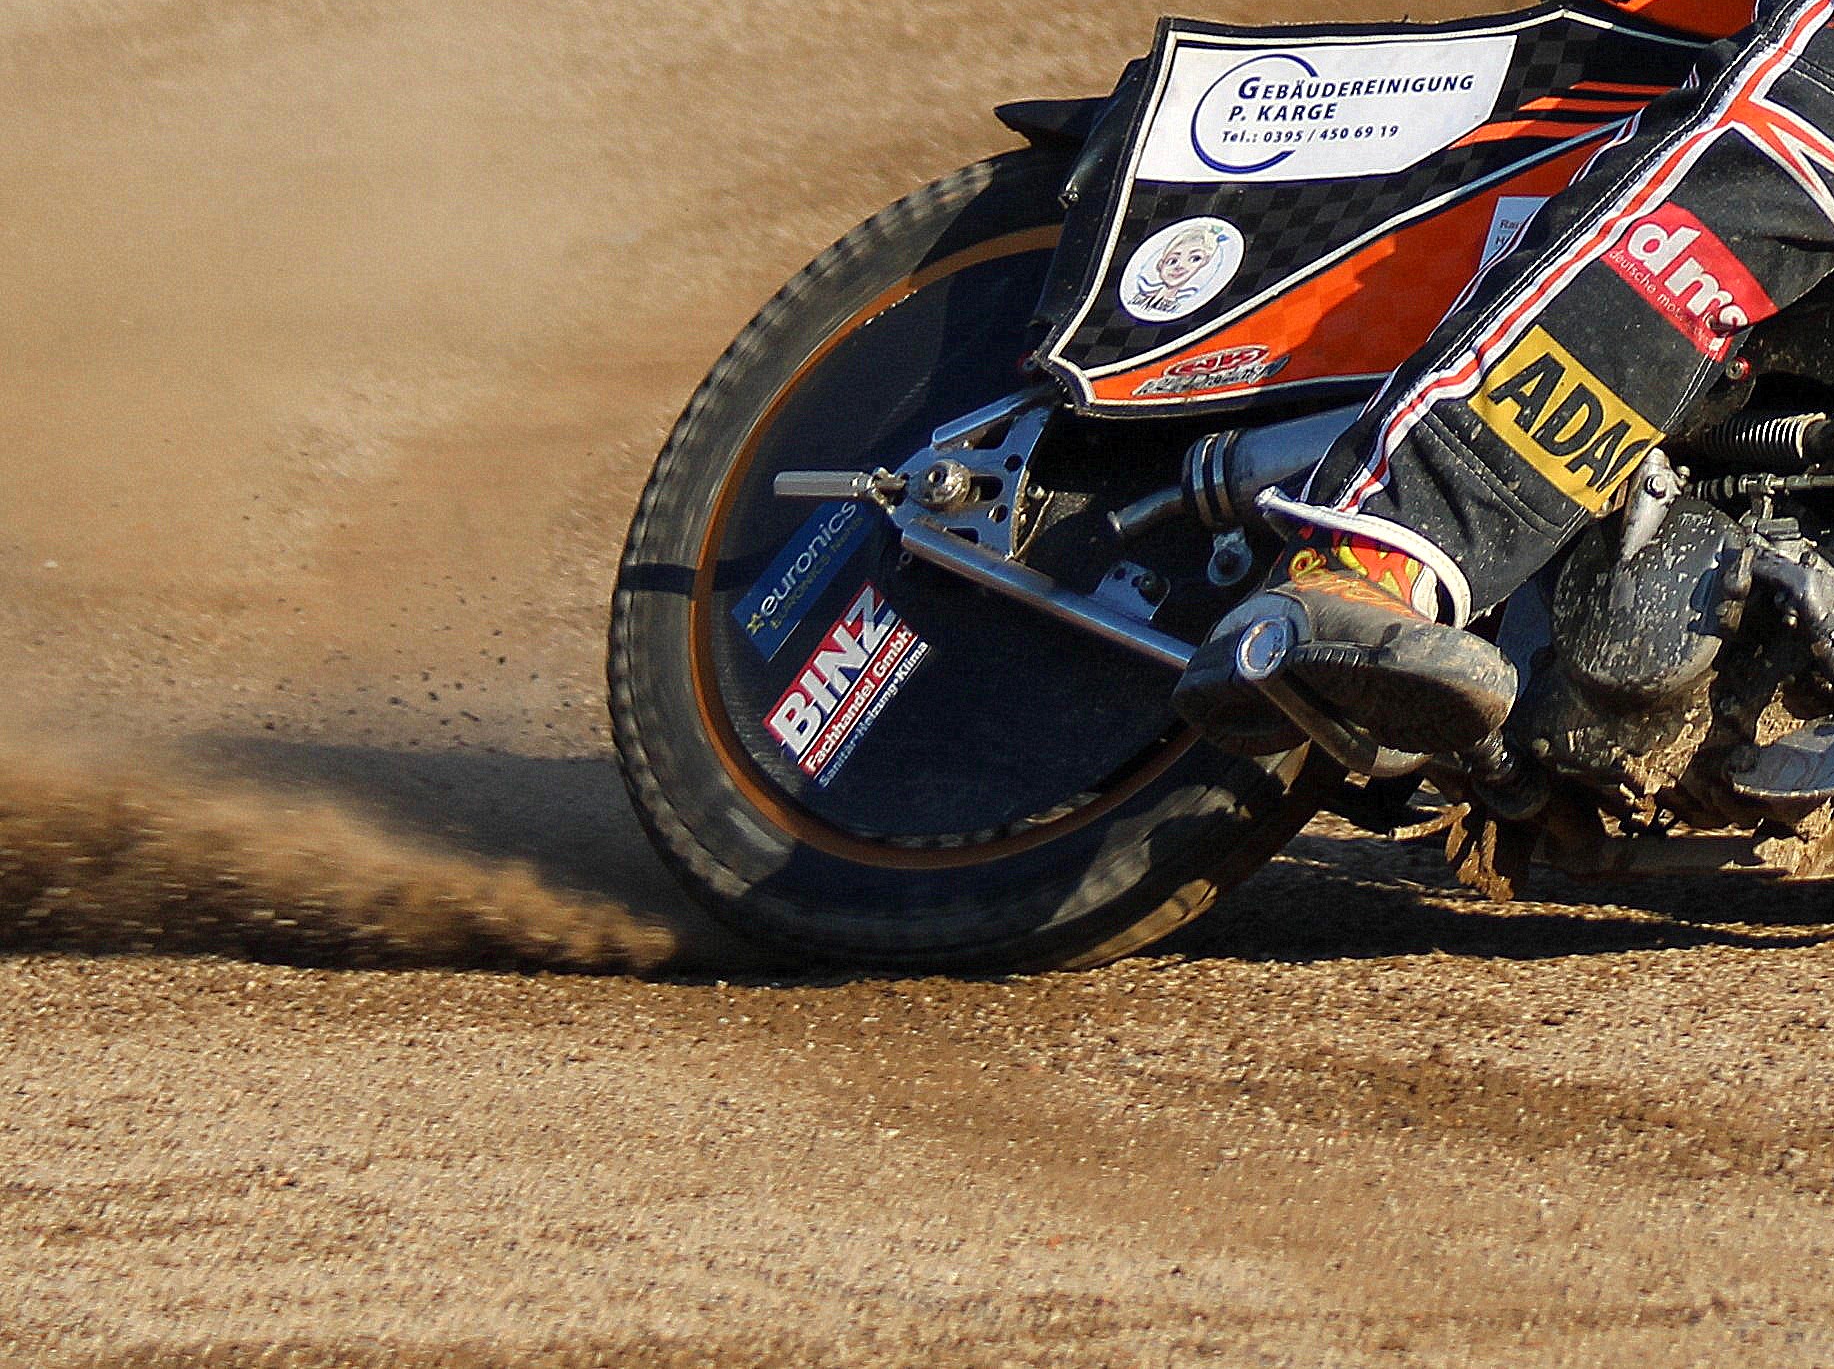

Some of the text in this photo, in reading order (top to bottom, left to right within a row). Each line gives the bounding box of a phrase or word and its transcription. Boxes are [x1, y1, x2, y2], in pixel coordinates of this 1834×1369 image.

[1228, 102, 1338, 123] P. KARGE
[1238, 74, 1475, 100] GEBÄUDEREINIGUNG
[1221, 130, 1257, 143] Tel.:
[1263, 129, 1302, 143] 0395
[1319, 127, 1349, 141] 450
[1354, 125, 1374, 138] 69
[1380, 125, 1400, 138] 19
[760, 502, 858, 617] euronics
[769, 584, 898, 756] BINZ
[805, 678, 876, 772] Fachhandel
[872, 625, 914, 679] GmbH
